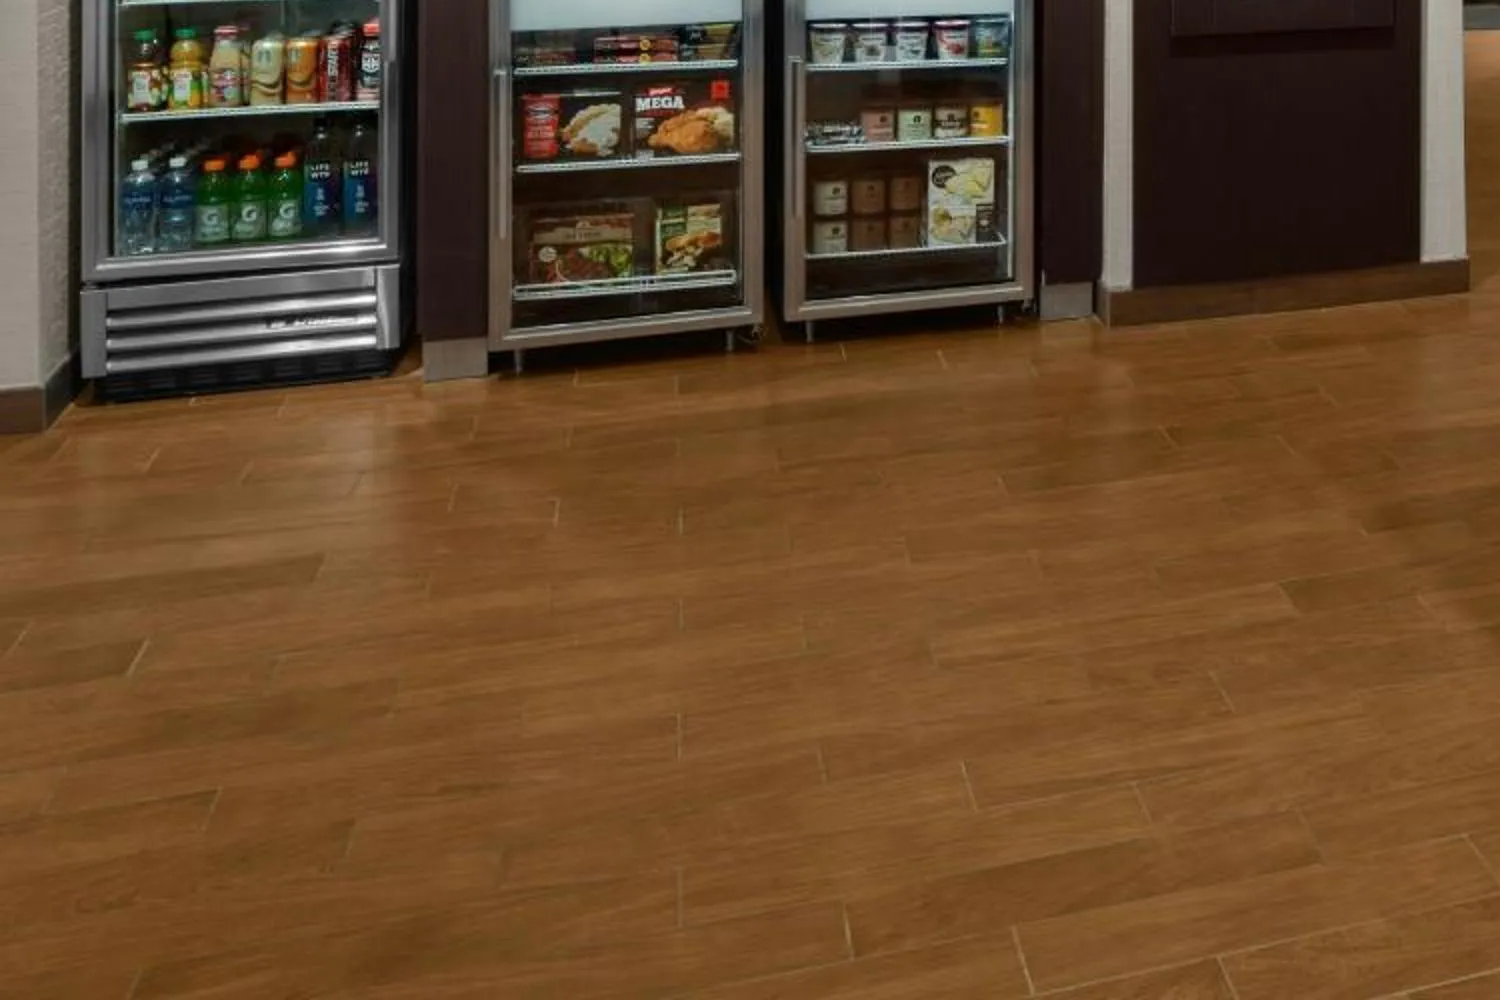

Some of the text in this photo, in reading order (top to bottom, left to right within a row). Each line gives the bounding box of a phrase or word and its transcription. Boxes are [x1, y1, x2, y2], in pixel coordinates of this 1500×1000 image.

[635, 96, 685, 112] MEGA
[242, 204, 258, 222] G
[279, 202, 296, 219] G
